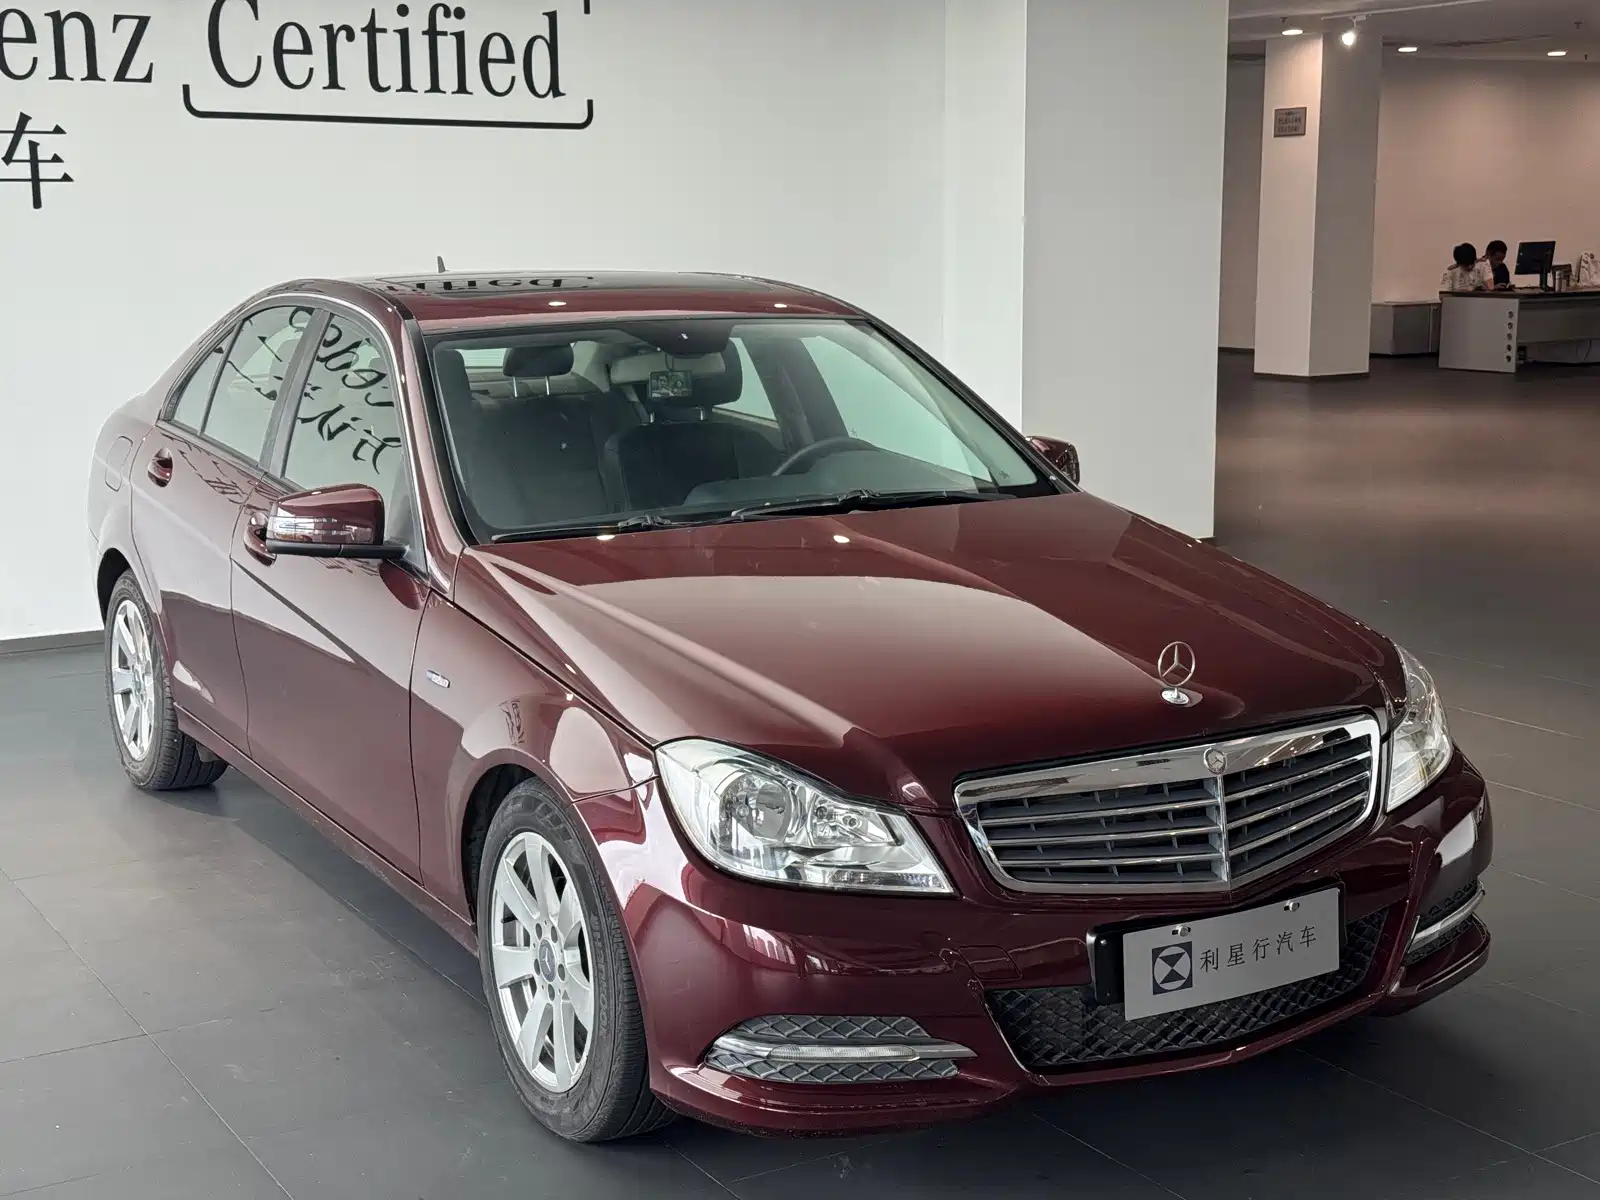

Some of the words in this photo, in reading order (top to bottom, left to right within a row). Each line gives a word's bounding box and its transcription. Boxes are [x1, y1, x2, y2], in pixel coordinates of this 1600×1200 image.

[0, 7, 154, 84] enz
[207, 0, 566, 98] Certified
[0, 112, 74, 210] 车
[1200, 925, 1317, 973] 利星行汽车
